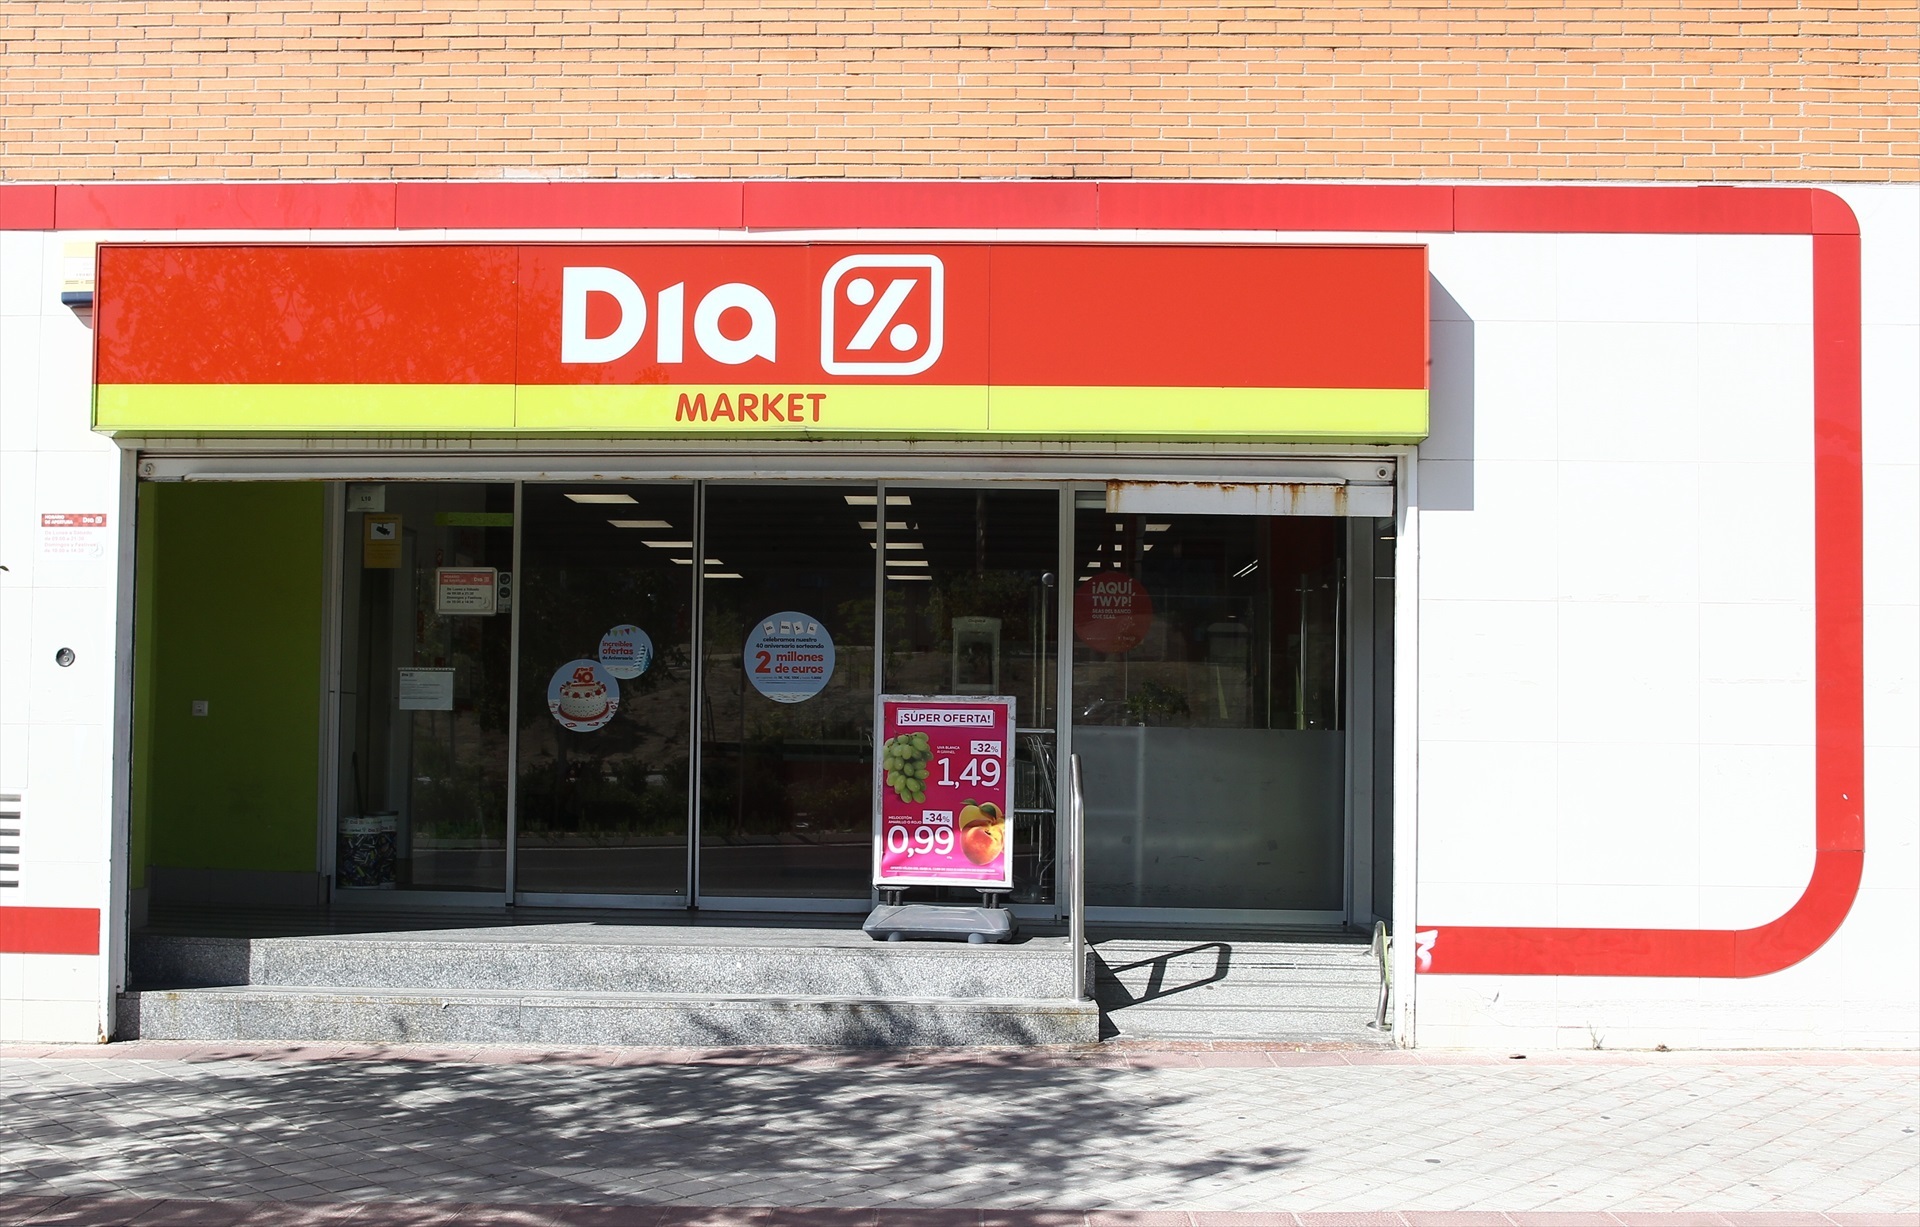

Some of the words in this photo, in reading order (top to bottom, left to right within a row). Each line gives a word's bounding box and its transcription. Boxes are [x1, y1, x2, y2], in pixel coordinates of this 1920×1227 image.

[675, 393, 826, 421] MARKET
[602, 647, 634, 655] ofertas
[755, 650, 771, 673] 2
[776, 651, 824, 662] millones
[774, 663, 789, 674] de
[791, 665, 824, 674] euros
[573, 668, 593, 683] 40
[900, 710, 940, 724] ¡SÚPER
[943, 712, 991, 723] OFERTA!
[973, 743, 999, 753] -32%
[937, 757, 1001, 789] 1,49
[925, 813, 950, 823] -34%
[887, 825, 954, 858] 0,99
